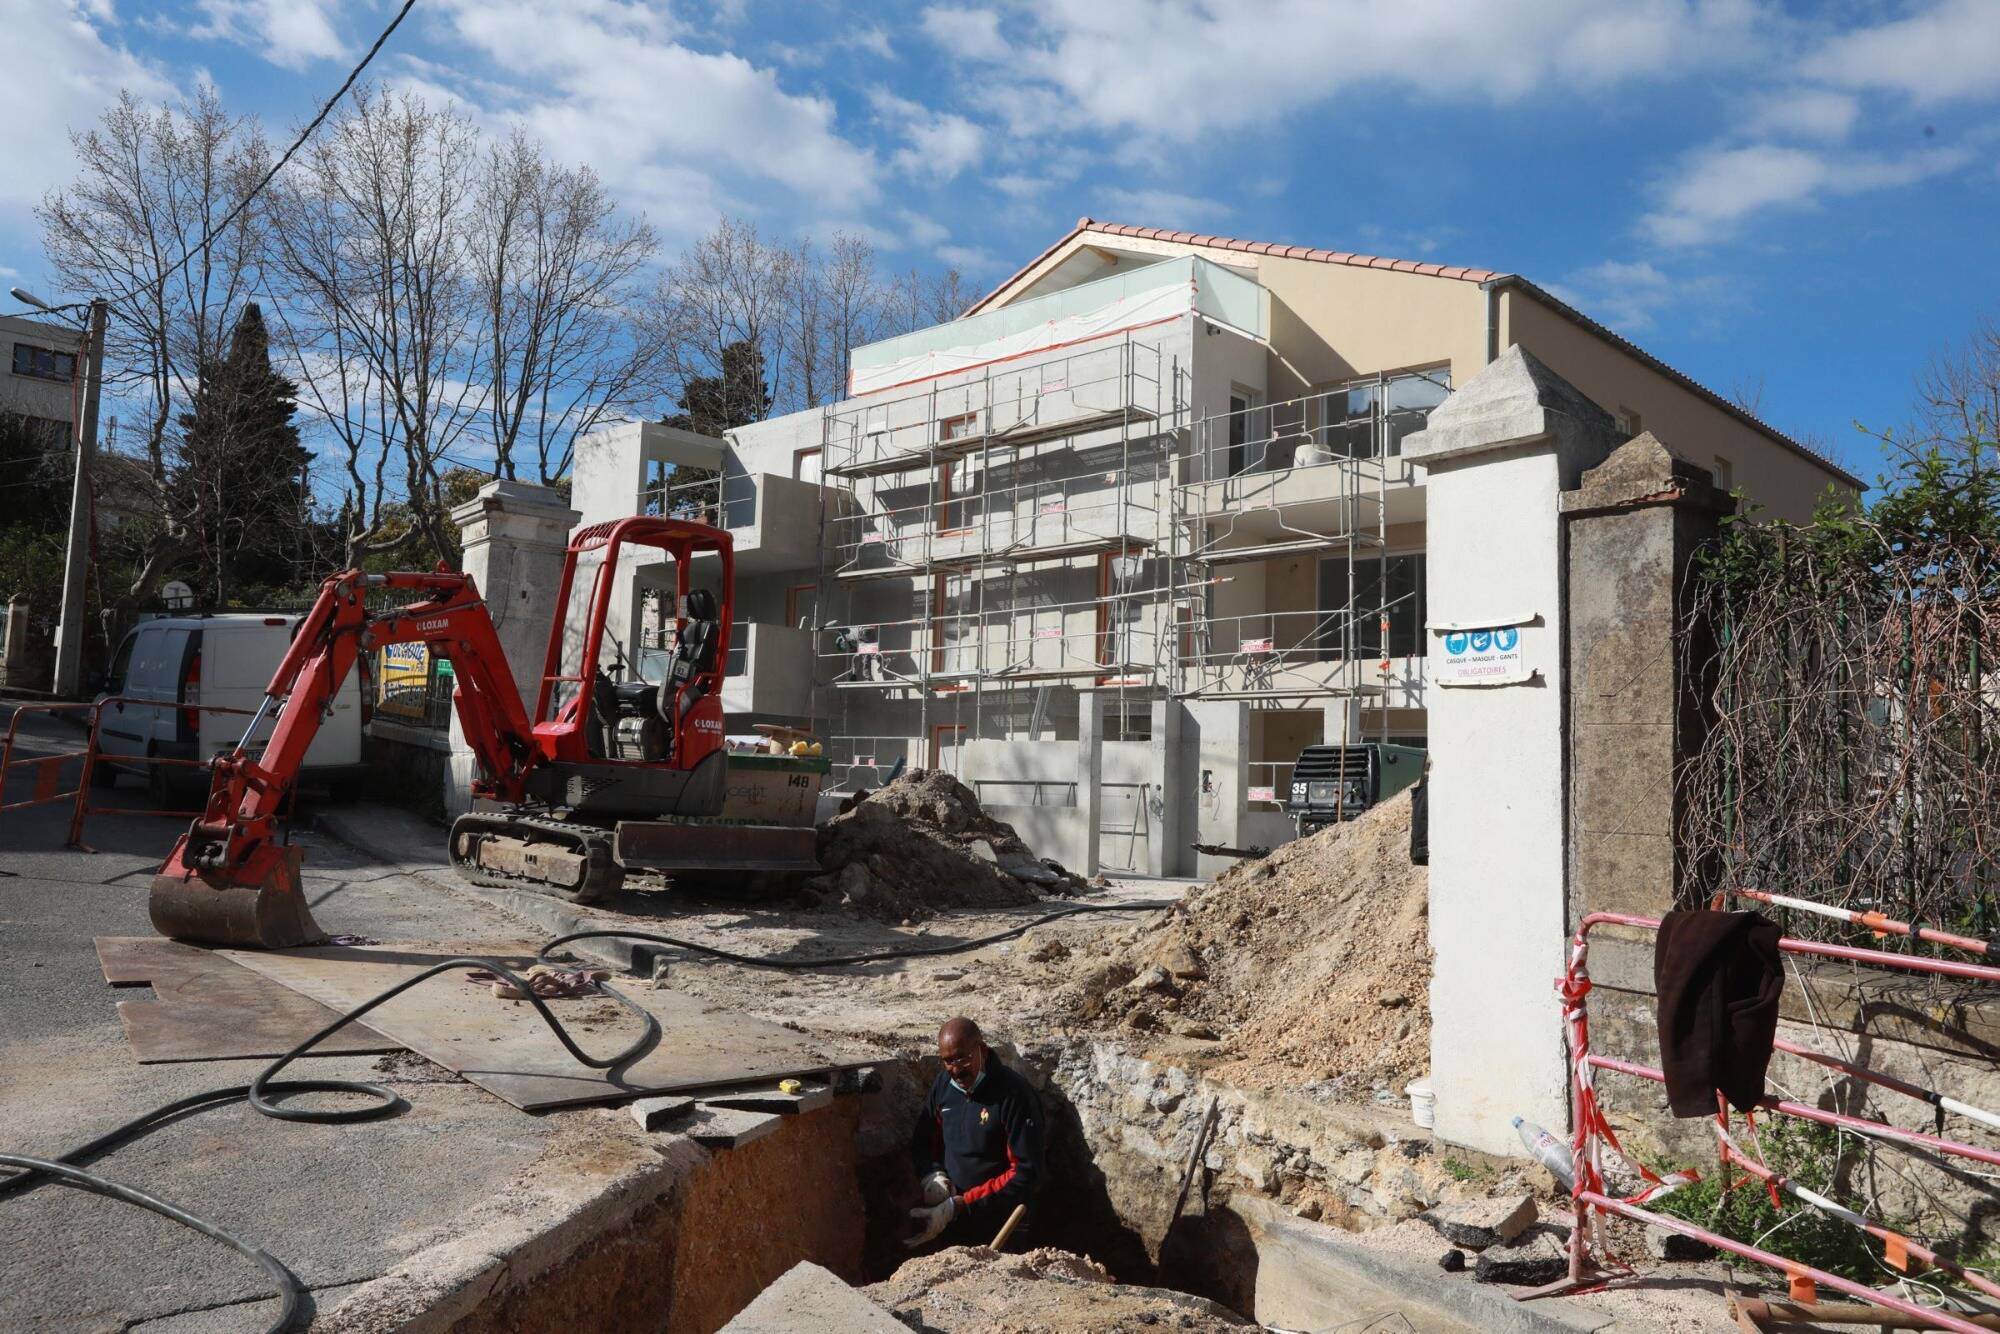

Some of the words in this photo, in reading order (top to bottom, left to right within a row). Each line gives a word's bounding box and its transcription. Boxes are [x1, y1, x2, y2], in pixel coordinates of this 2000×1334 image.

[422, 618, 449, 631] LOXAM
[1457, 666, 1505, 677] OBLIGATOIRES
[788, 774, 809, 788] 148
[1292, 783, 1307, 794] 35
